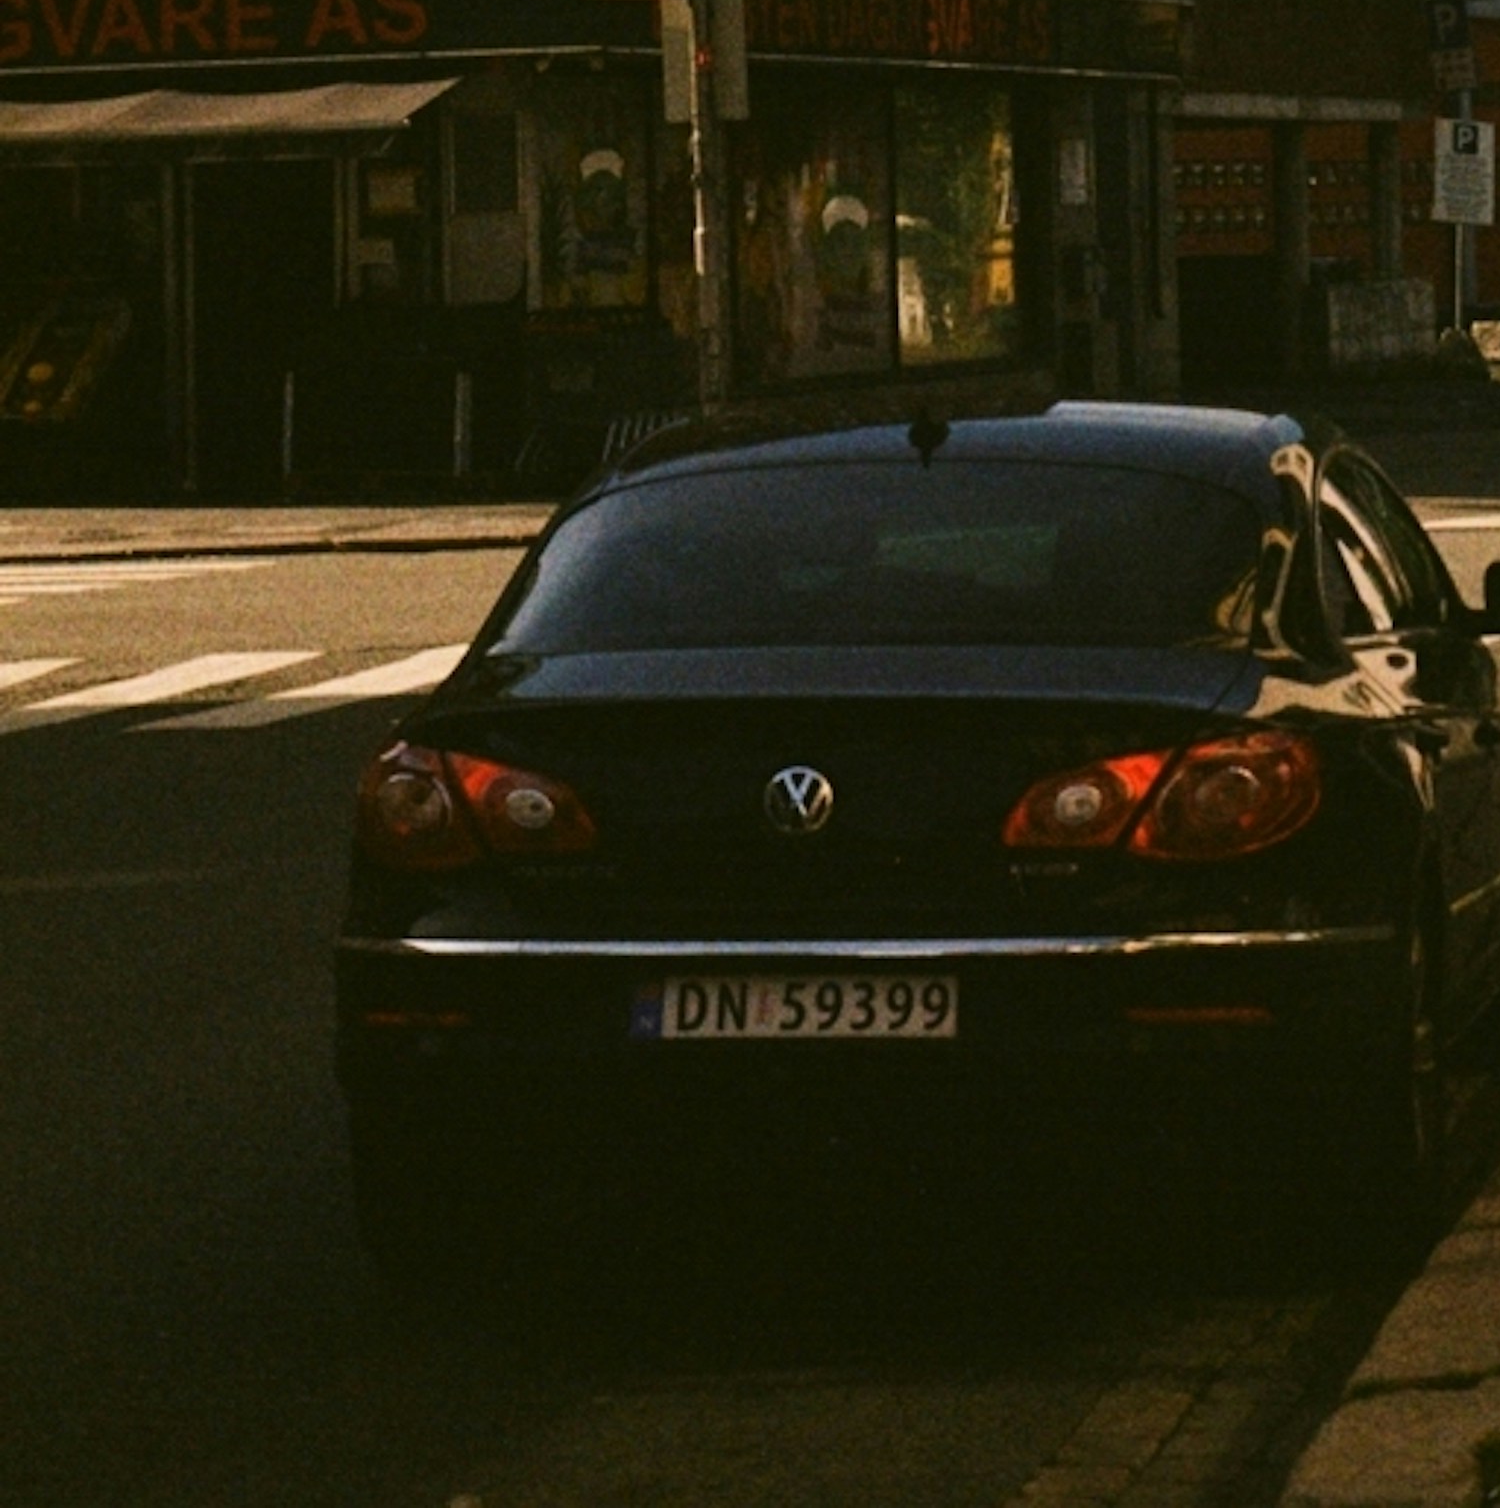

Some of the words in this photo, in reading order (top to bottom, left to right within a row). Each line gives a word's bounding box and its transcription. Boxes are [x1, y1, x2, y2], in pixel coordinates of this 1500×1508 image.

[1457, 126, 1475, 150] P
[676, 981, 749, 1031] DN
[778, 981, 951, 1032] 59399
